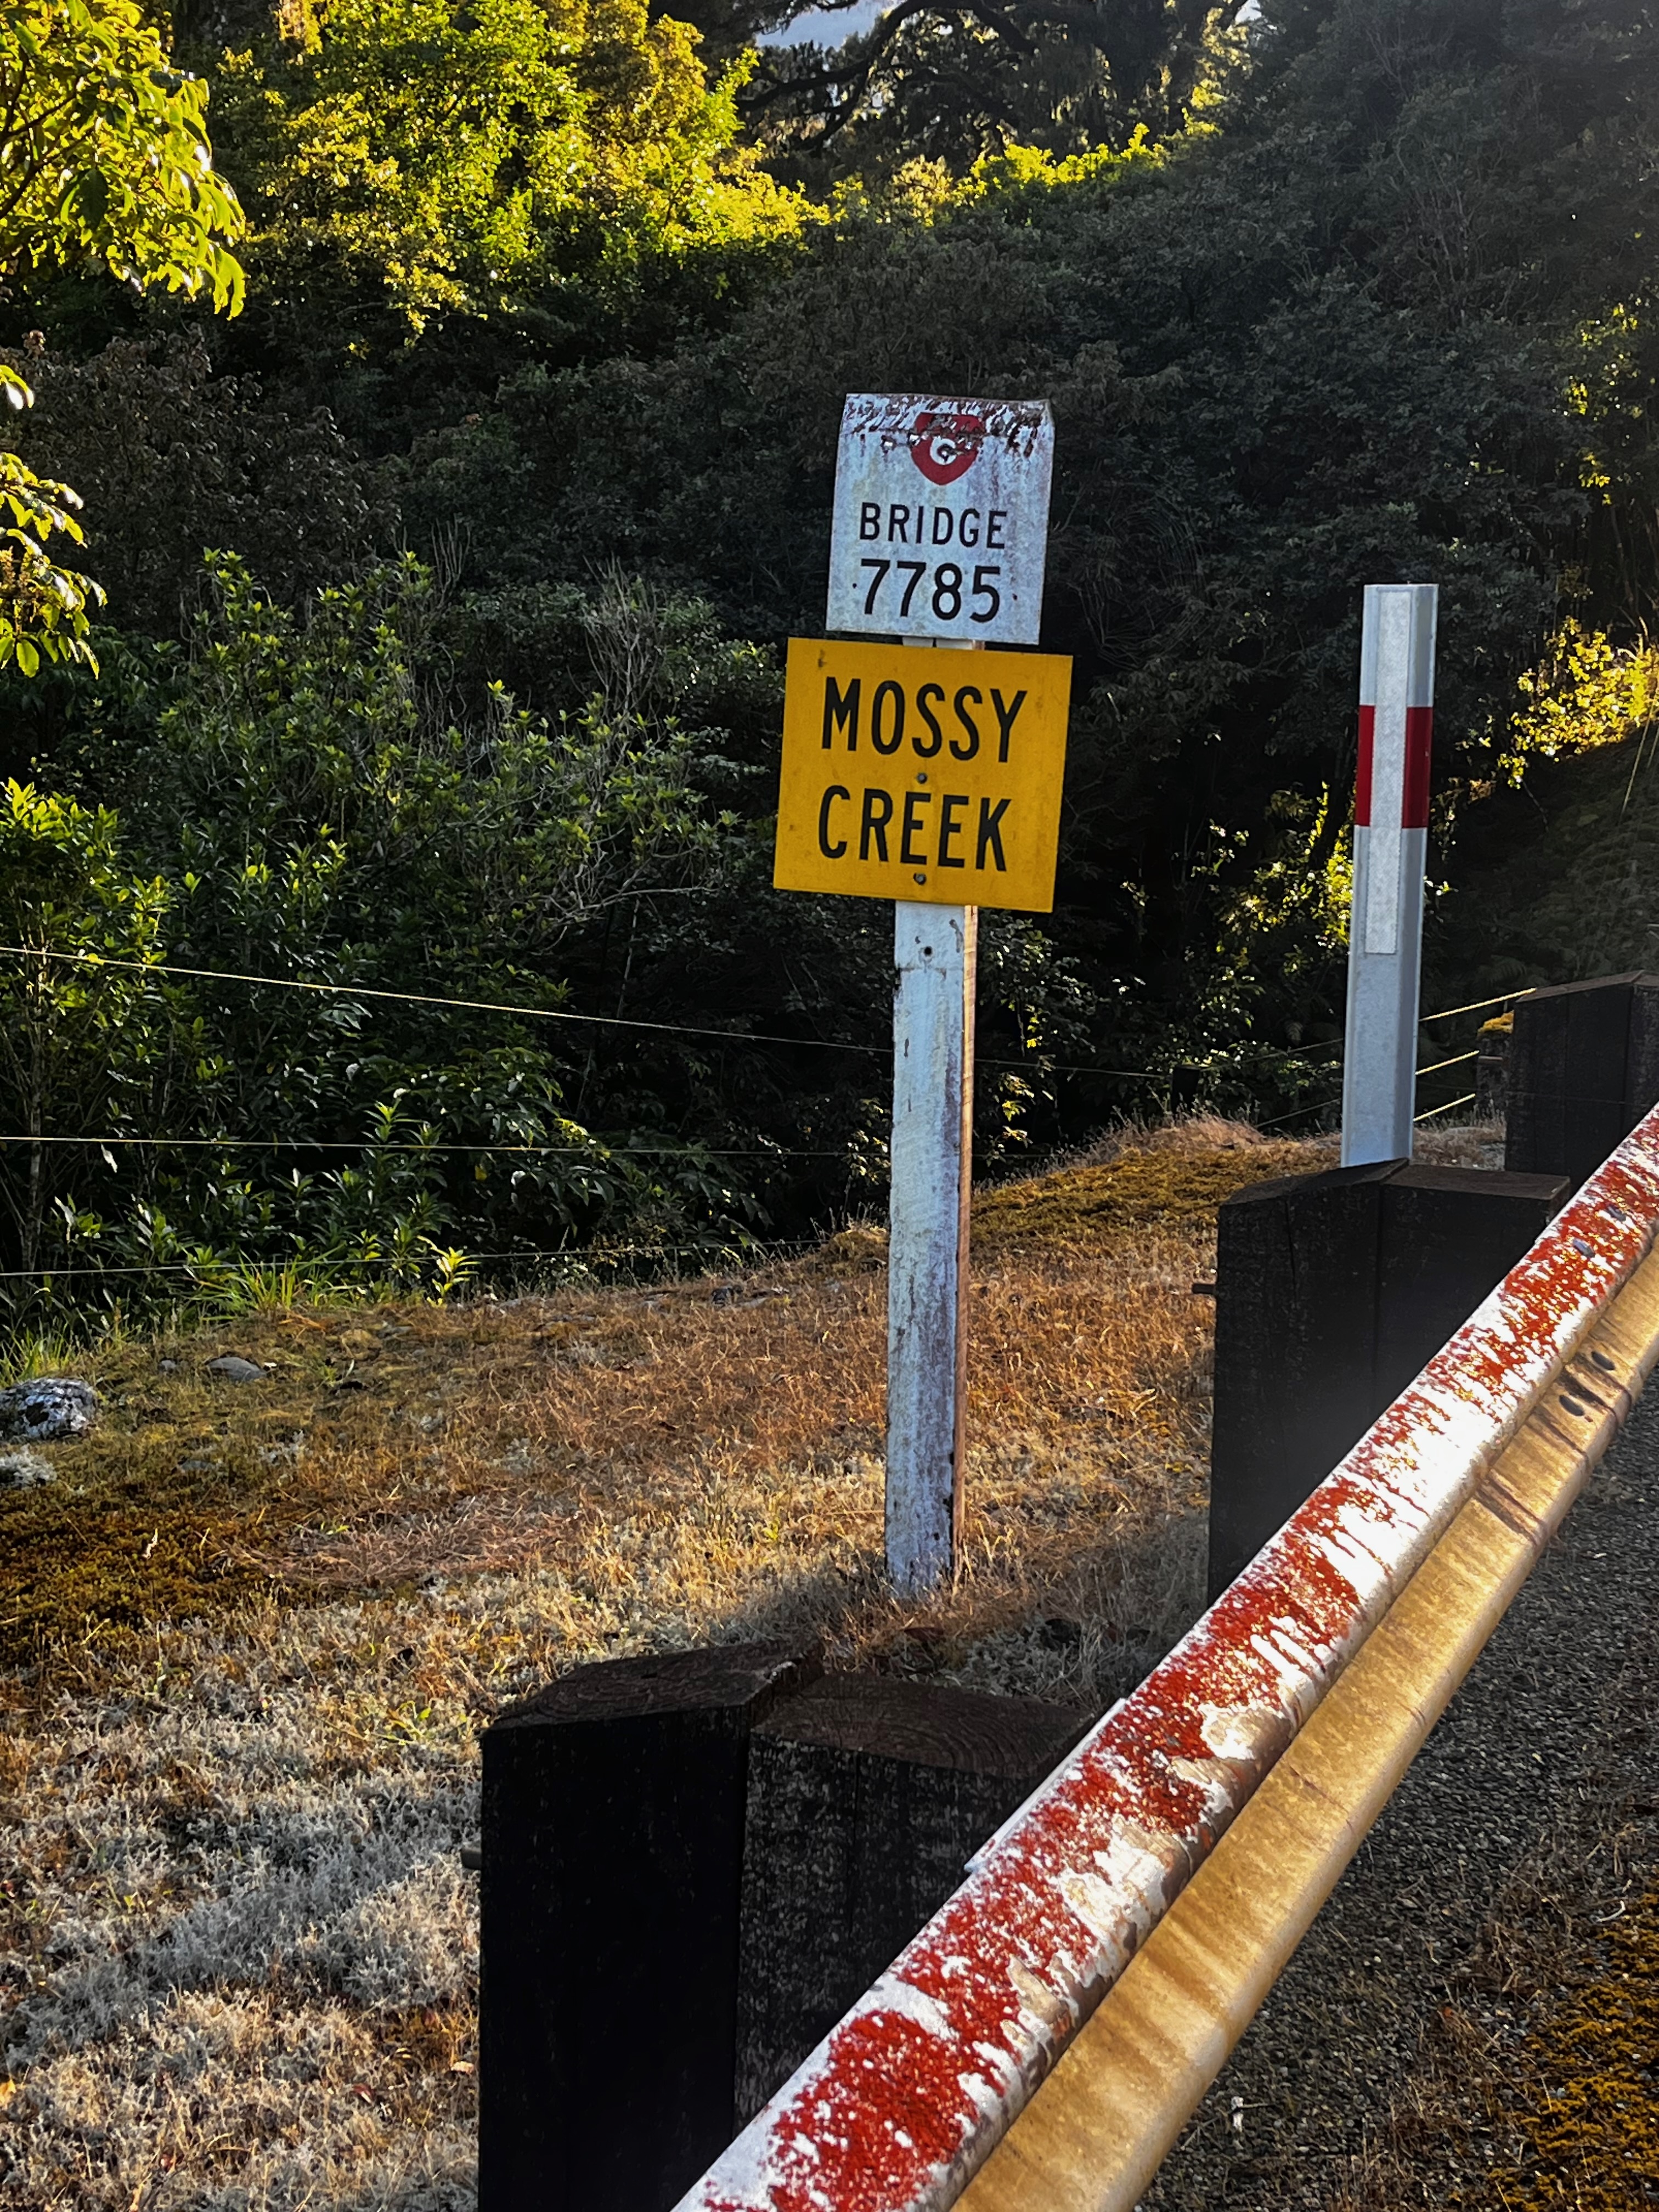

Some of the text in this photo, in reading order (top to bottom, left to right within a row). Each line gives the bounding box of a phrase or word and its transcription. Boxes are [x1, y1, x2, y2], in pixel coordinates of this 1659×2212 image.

[860, 502, 1007, 549] BRIDGE
[860, 558, 1001, 623] 7785
[822, 676, 1028, 763] MOSSY
[819, 785, 1012, 872] CREEK
